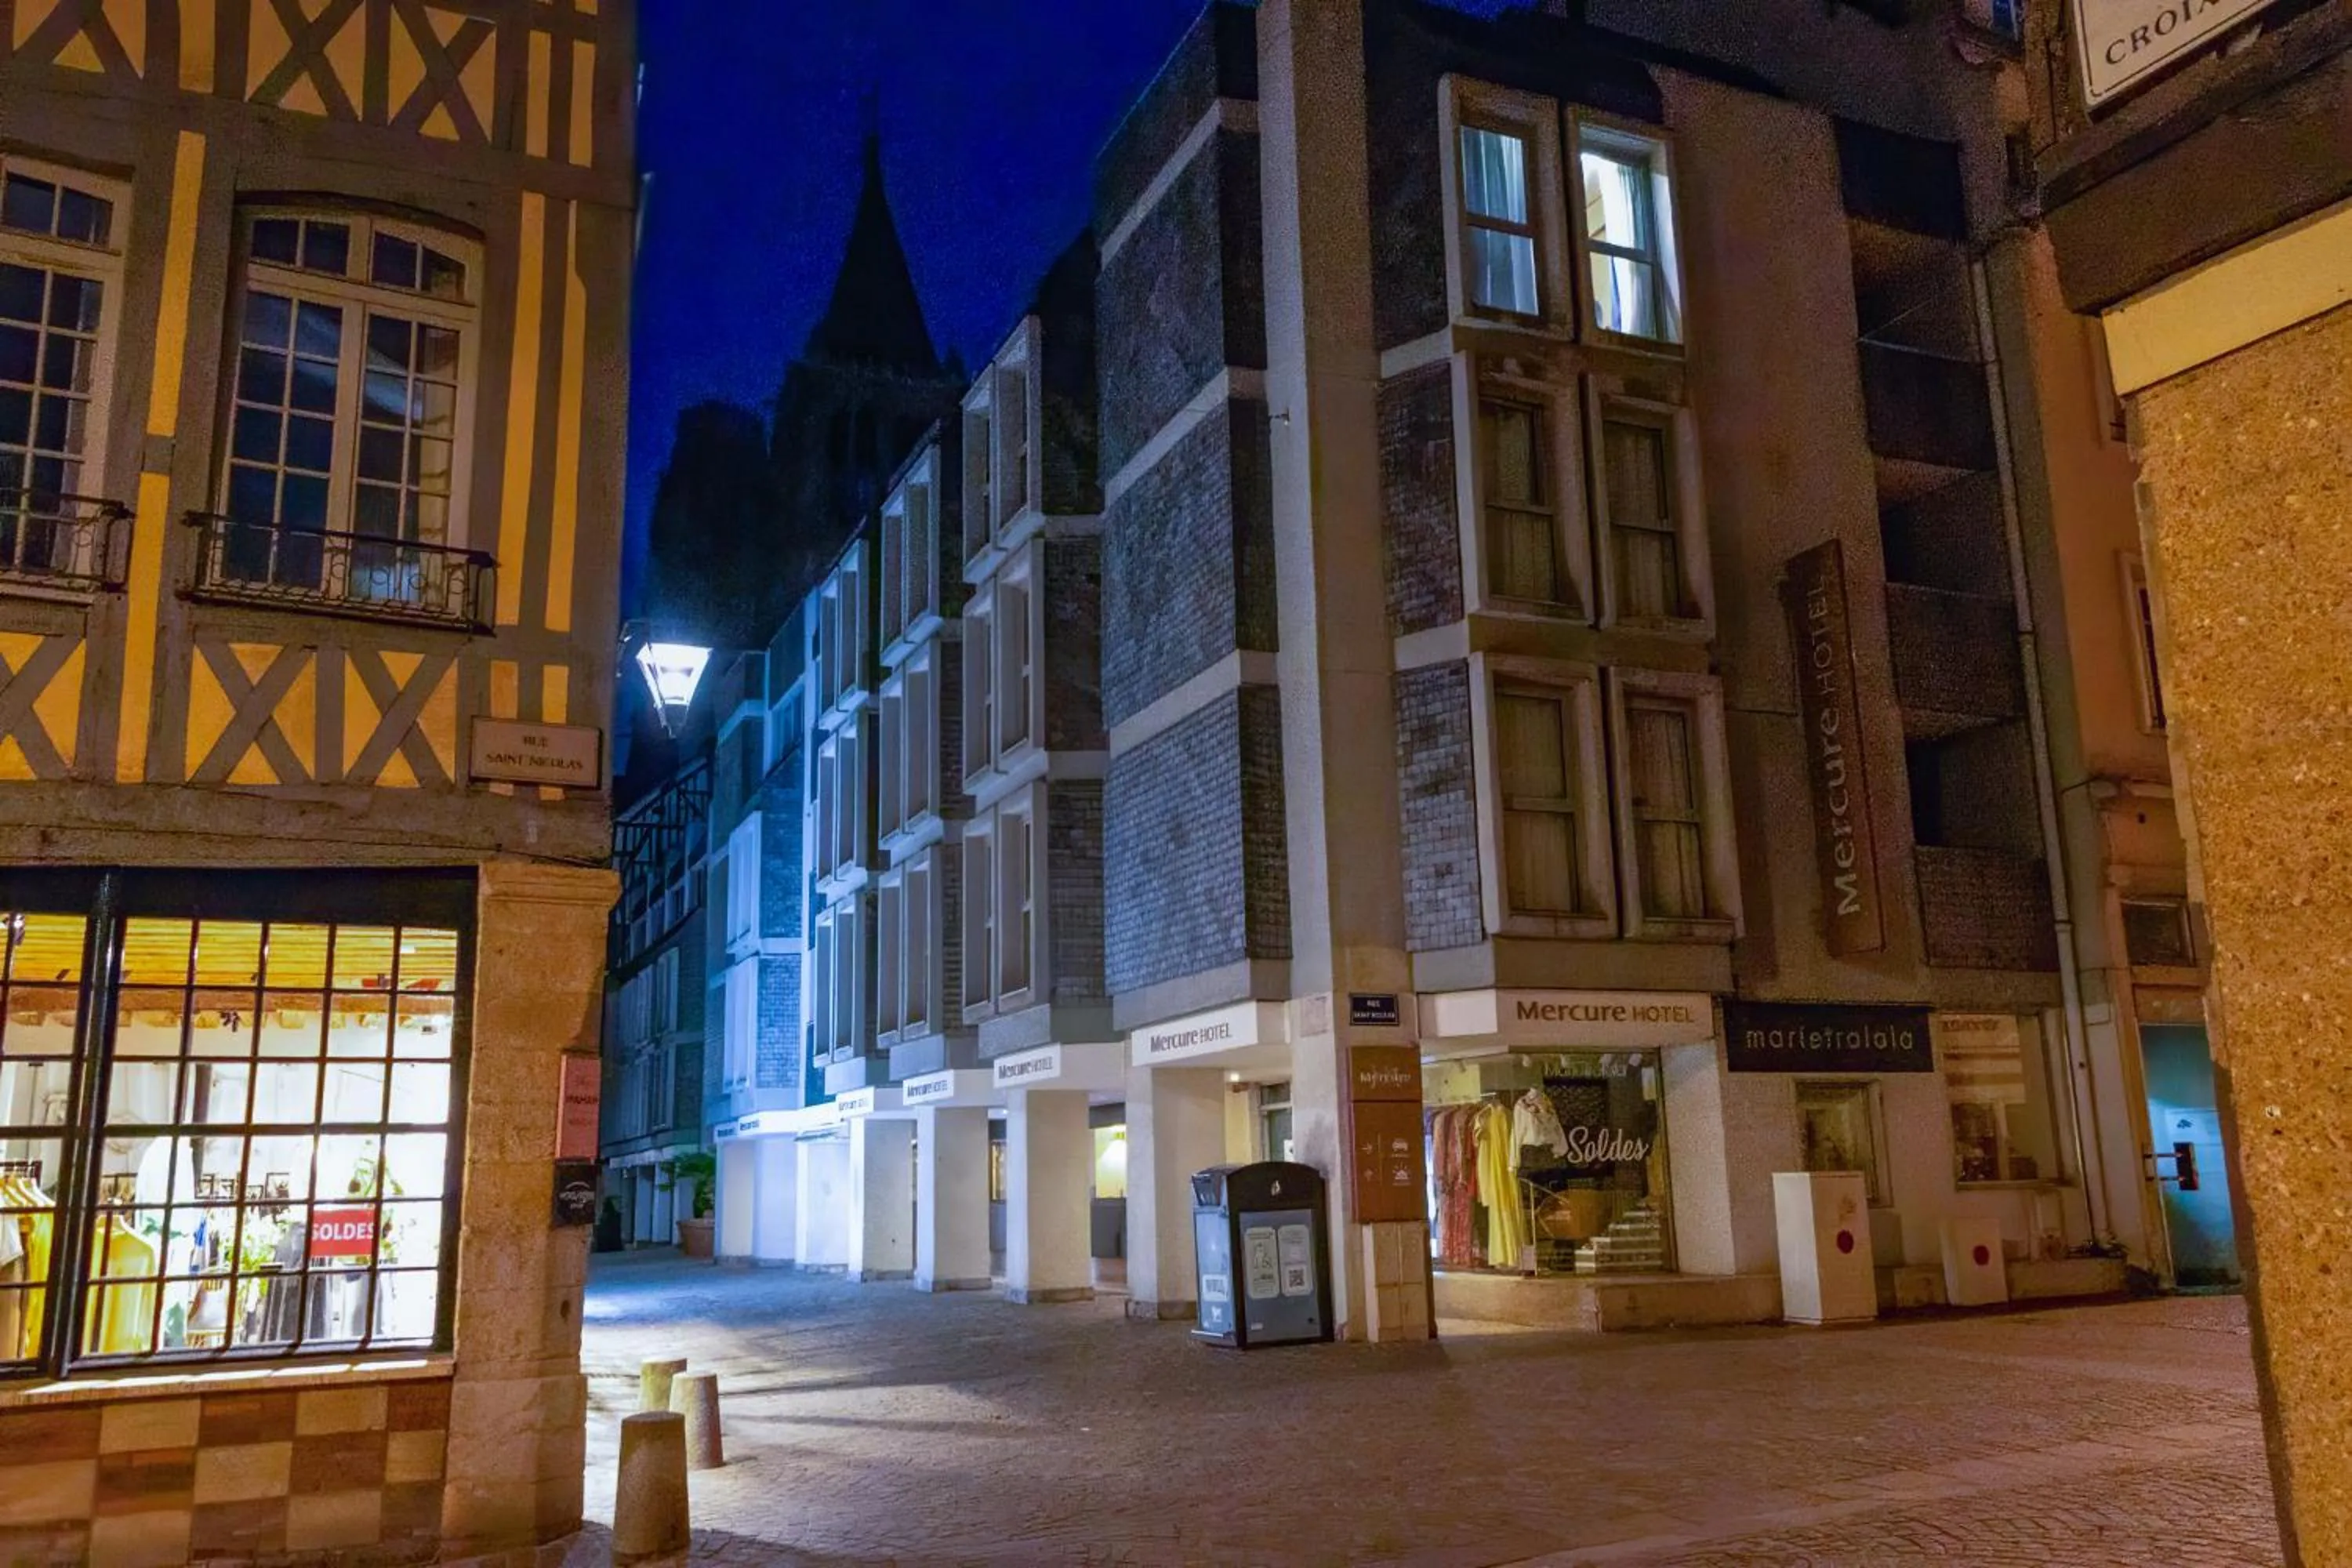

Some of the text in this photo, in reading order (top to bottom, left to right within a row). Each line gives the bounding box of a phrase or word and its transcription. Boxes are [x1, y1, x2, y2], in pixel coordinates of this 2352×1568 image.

[523, 735, 550, 748] RUE
[1807, 576, 1860, 916] Mercure HOTEL
[486, 752, 584, 770] SAINT NICOLAS
[1515, 1000, 1695, 1023] Mercure HOTEL
[1150, 1022, 1232, 1053] Mercure HOTEL
[1566, 1126, 1649, 1163] Soldes
[311, 1222, 374, 1240] SOLDES
